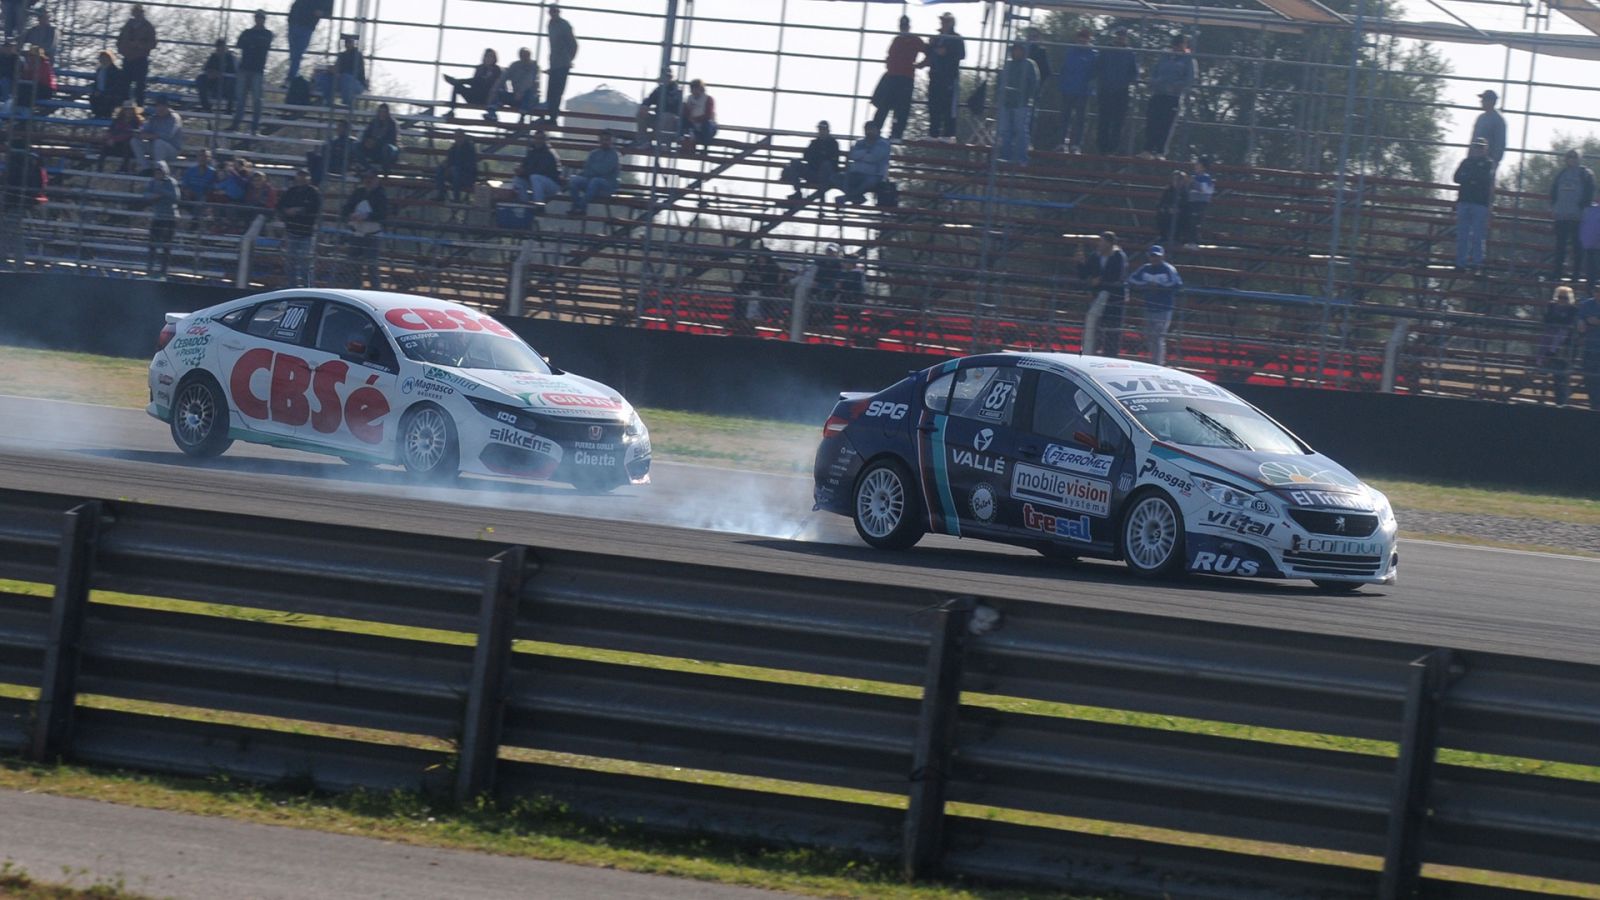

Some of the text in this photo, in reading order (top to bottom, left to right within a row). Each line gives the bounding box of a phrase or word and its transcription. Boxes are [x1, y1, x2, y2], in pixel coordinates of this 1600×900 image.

[280, 307, 305, 330] 100
[230, 348, 390, 444] CBSé
[415, 379, 454, 395] Magnasco
[985, 381, 1012, 410] 83
[497, 411, 518, 424] 100
[865, 400, 909, 420] SPG
[1130, 404, 1148, 412] C3
[489, 427, 552, 453] sikkens
[575, 451, 616, 466] Cherta
[952, 448, 1006, 475] VALLÉ
[1048, 450, 1111, 470] FIERROMEC
[1016, 471, 1108, 503] mobilevision
[1138, 458, 1193, 492] Phosgas
[1062, 498, 1107, 514] systems
[1256, 501, 1267, 511] 83
[1023, 503, 1092, 543] tresal
[1206, 509, 1277, 538] vittal
[1191, 550, 1261, 577] RUS
